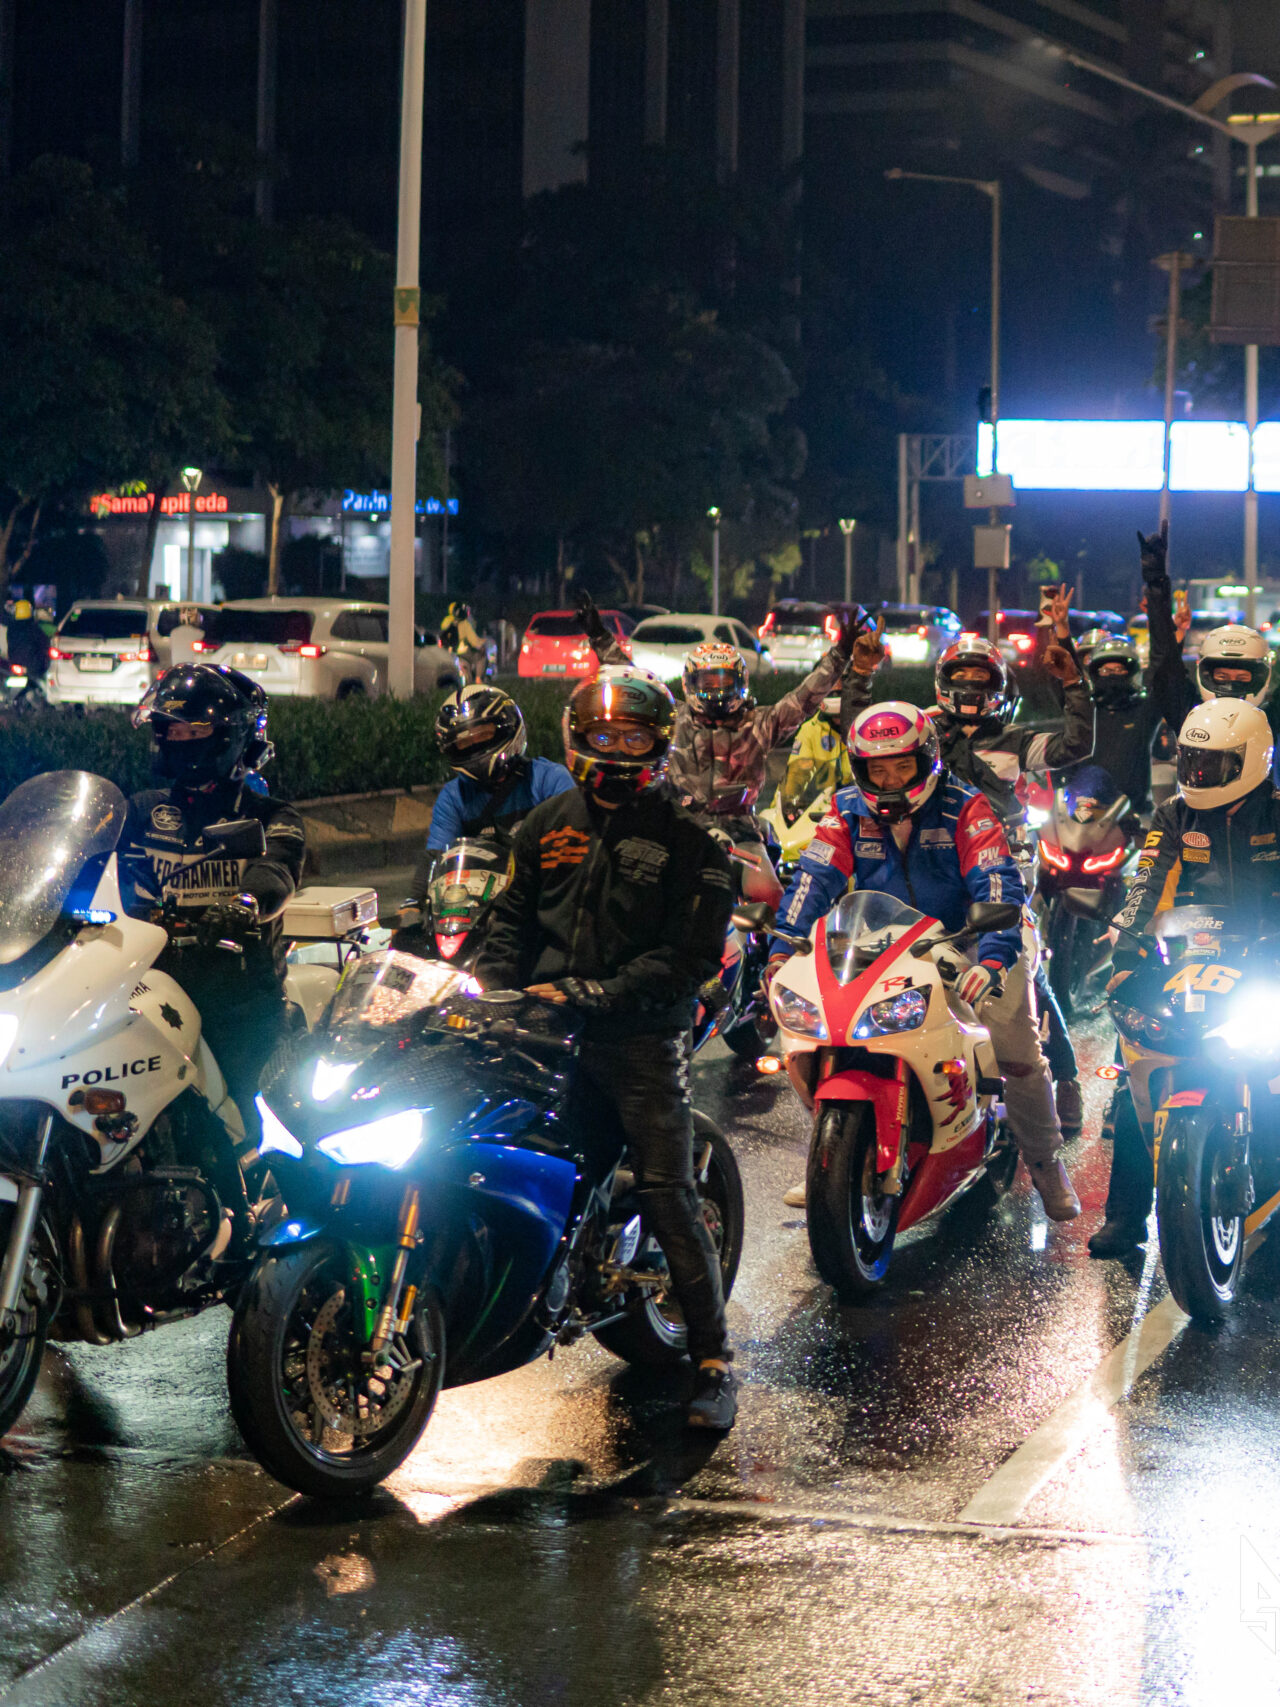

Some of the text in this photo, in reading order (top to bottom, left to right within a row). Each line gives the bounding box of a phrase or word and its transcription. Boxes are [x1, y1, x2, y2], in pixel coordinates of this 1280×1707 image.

[1190, 729, 1208, 740] Arai
[1183, 920, 1225, 930] OGRE
[878, 975, 916, 993] R1
[1163, 963, 1243, 994] 46
[61, 1055, 162, 1090] POLICE
[895, 1086, 905, 1121] YAMAHA
